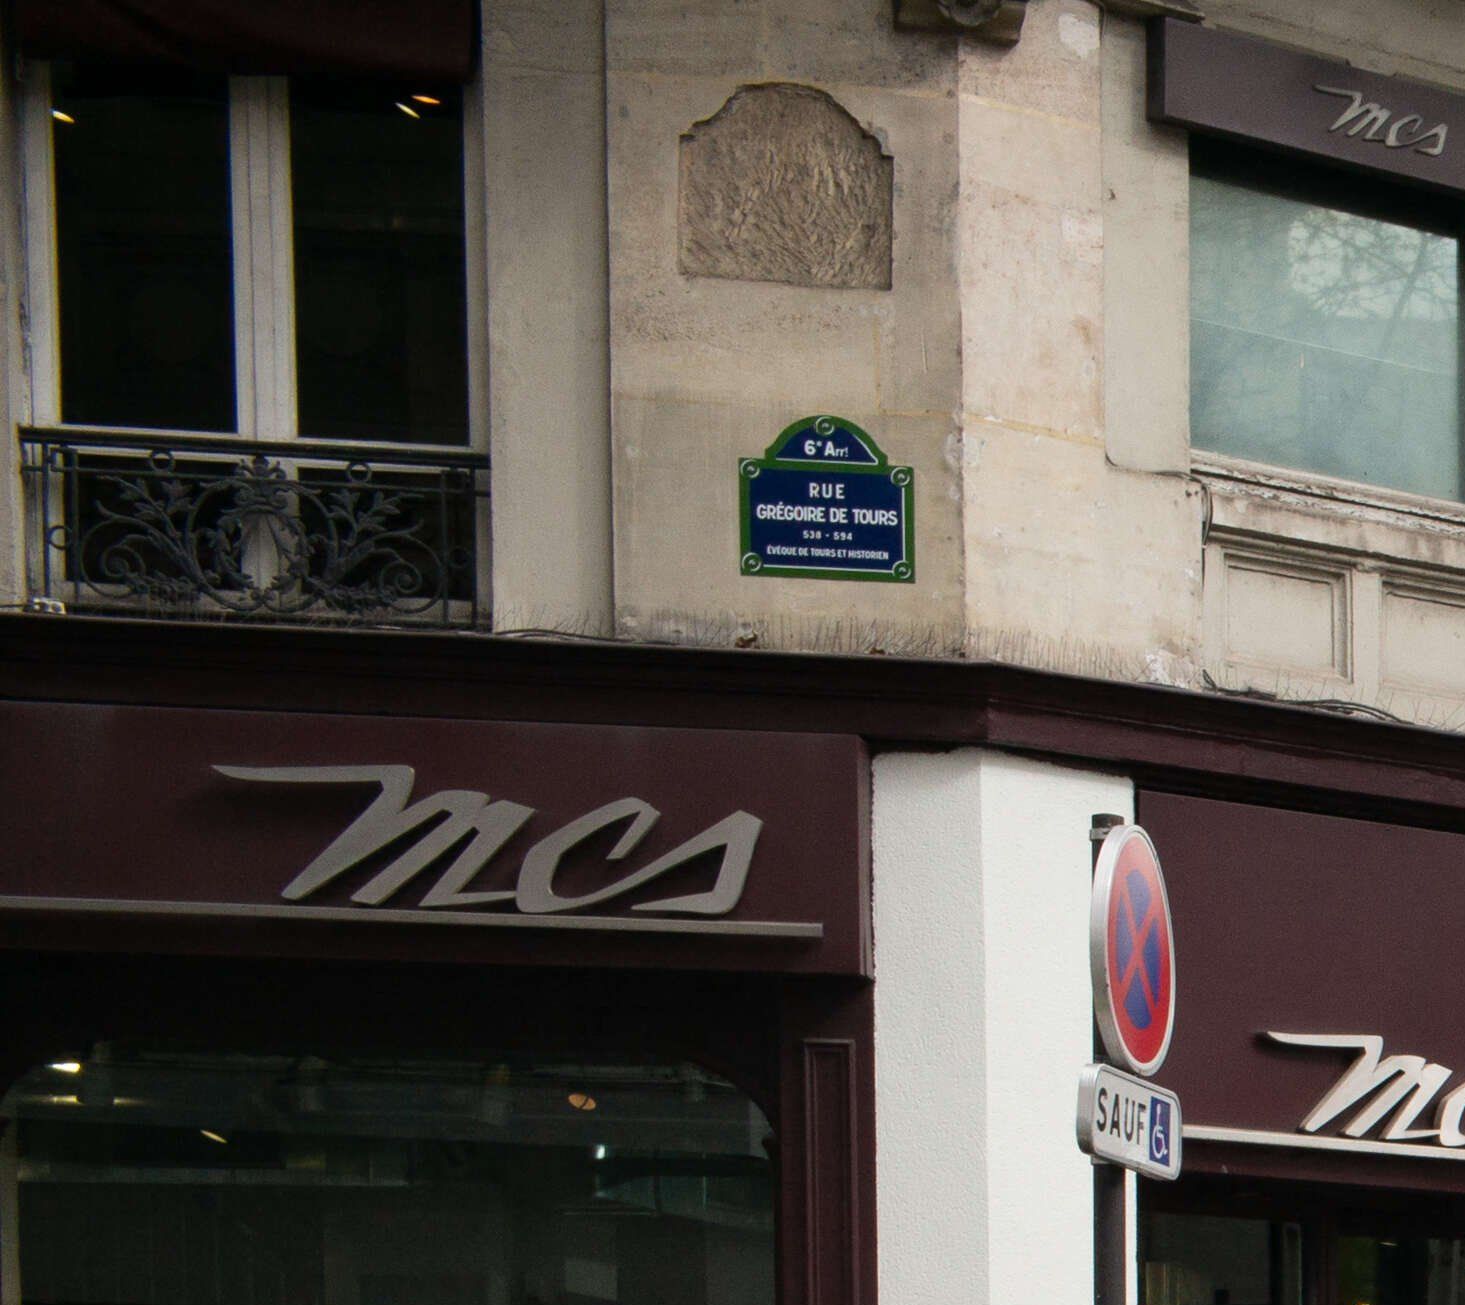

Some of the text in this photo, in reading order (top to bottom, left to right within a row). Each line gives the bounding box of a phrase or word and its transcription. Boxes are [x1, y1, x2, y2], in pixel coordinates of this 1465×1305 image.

[1313, 84, 1449, 157] mcs
[808, 482, 845, 499] RUE
[756, 501, 899, 526] GRÉGOIRE DE TOURS
[798, 547, 809, 556] DE
[810, 548, 836, 558] TOURS
[837, 549, 847, 558] ET
[848, 549, 889, 560] HISTORIEN
[211, 765, 763, 916] mcs
[1095, 1086, 1147, 1146] SAUF
